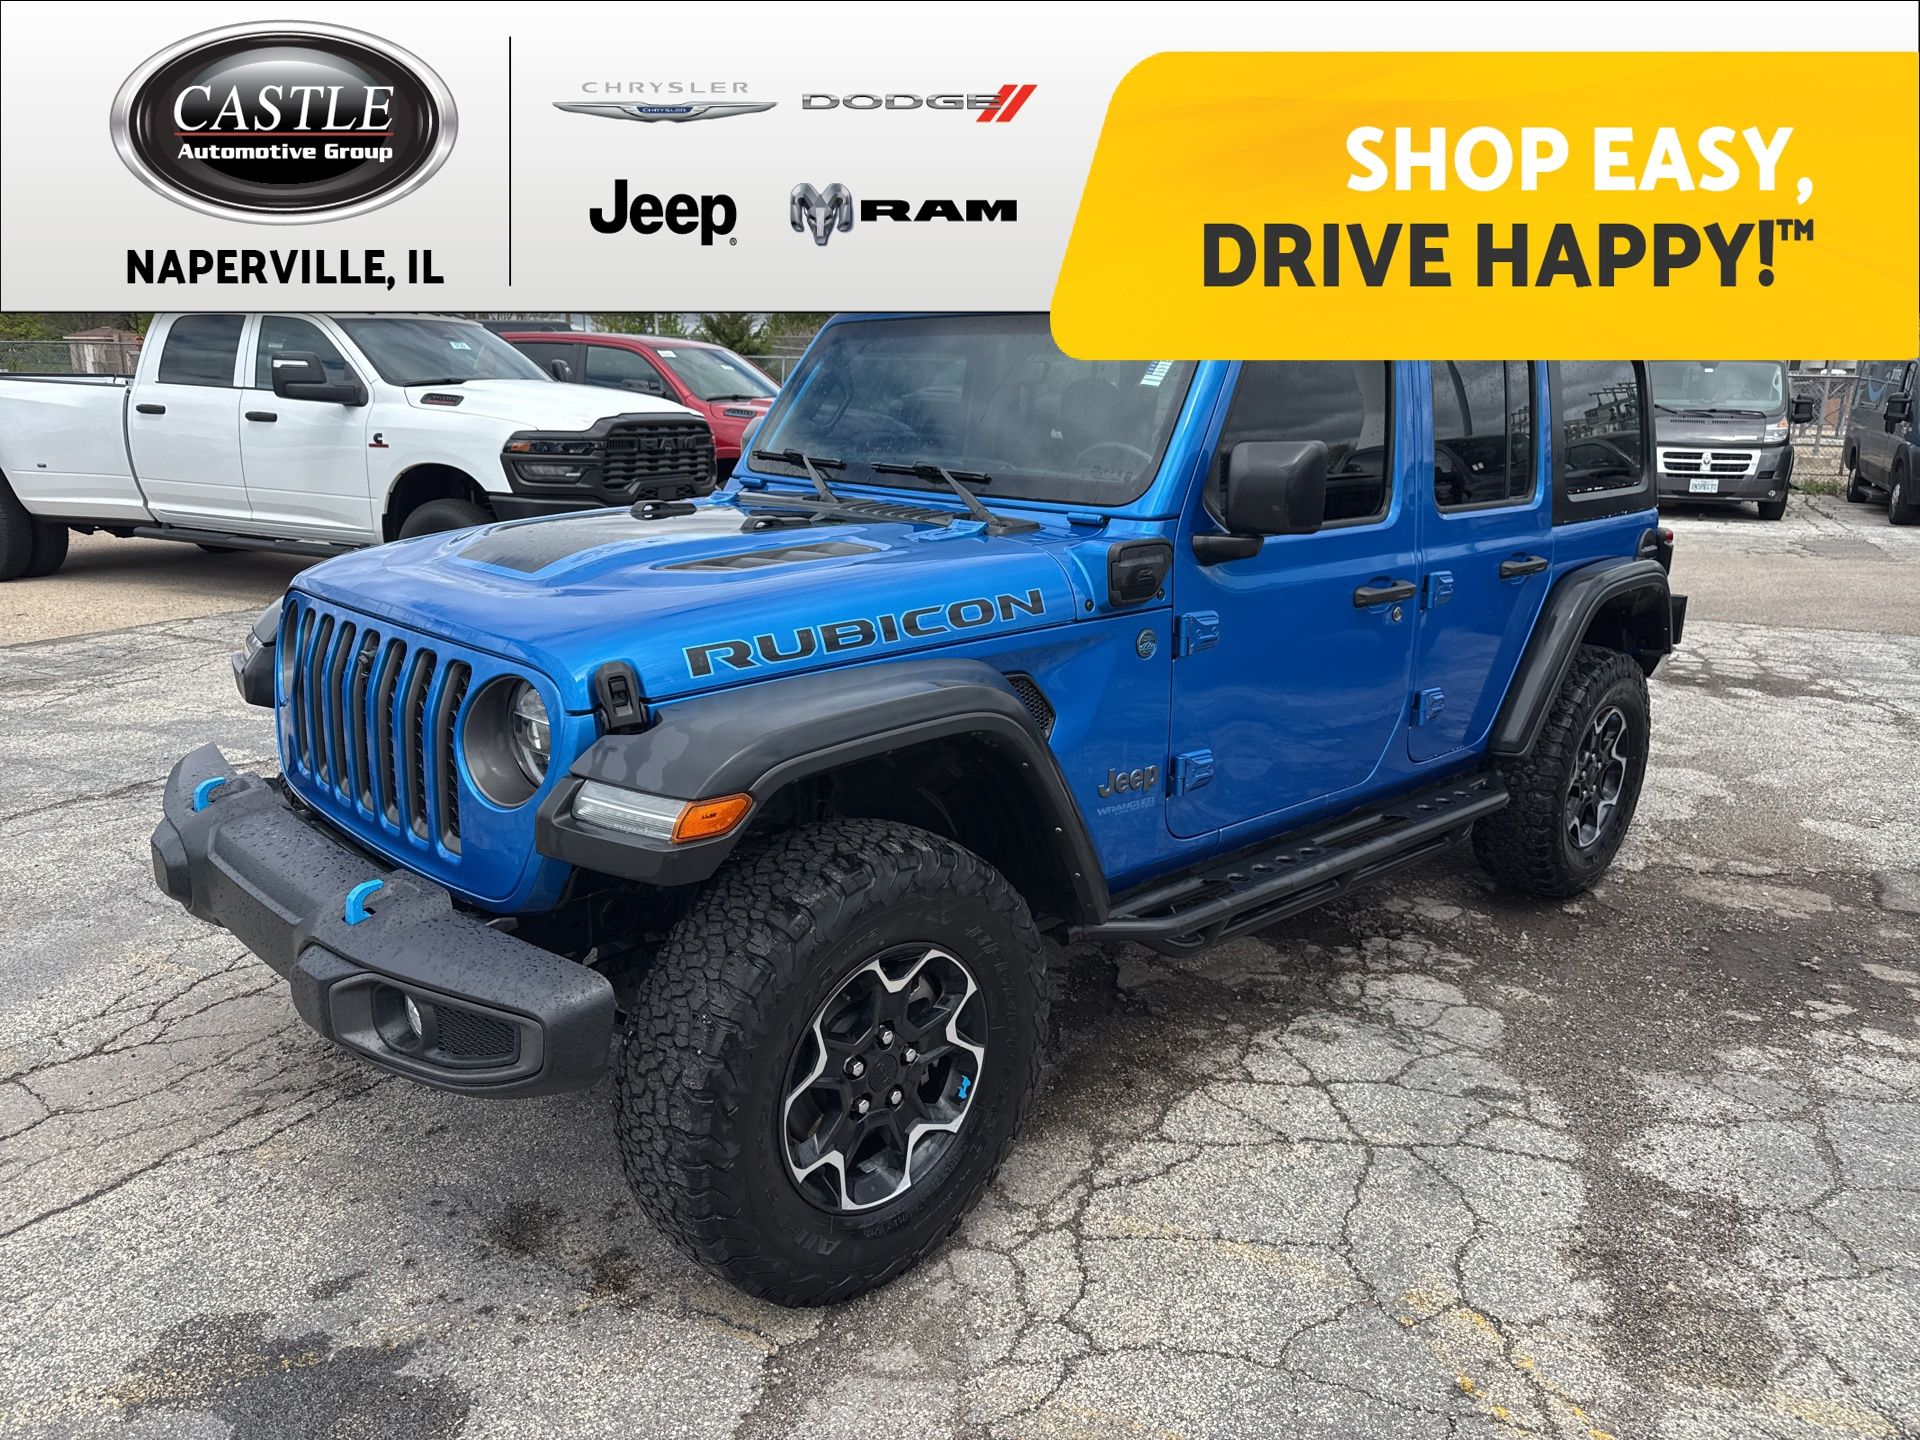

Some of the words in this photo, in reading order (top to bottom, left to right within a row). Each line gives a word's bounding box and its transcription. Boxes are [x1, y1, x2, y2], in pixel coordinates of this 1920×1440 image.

[639, 433, 698, 451] RAM
[685, 588, 1046, 679] RUBICON
[1097, 765, 1158, 798] Jeep
[1097, 796, 1156, 816] WRANGLER
